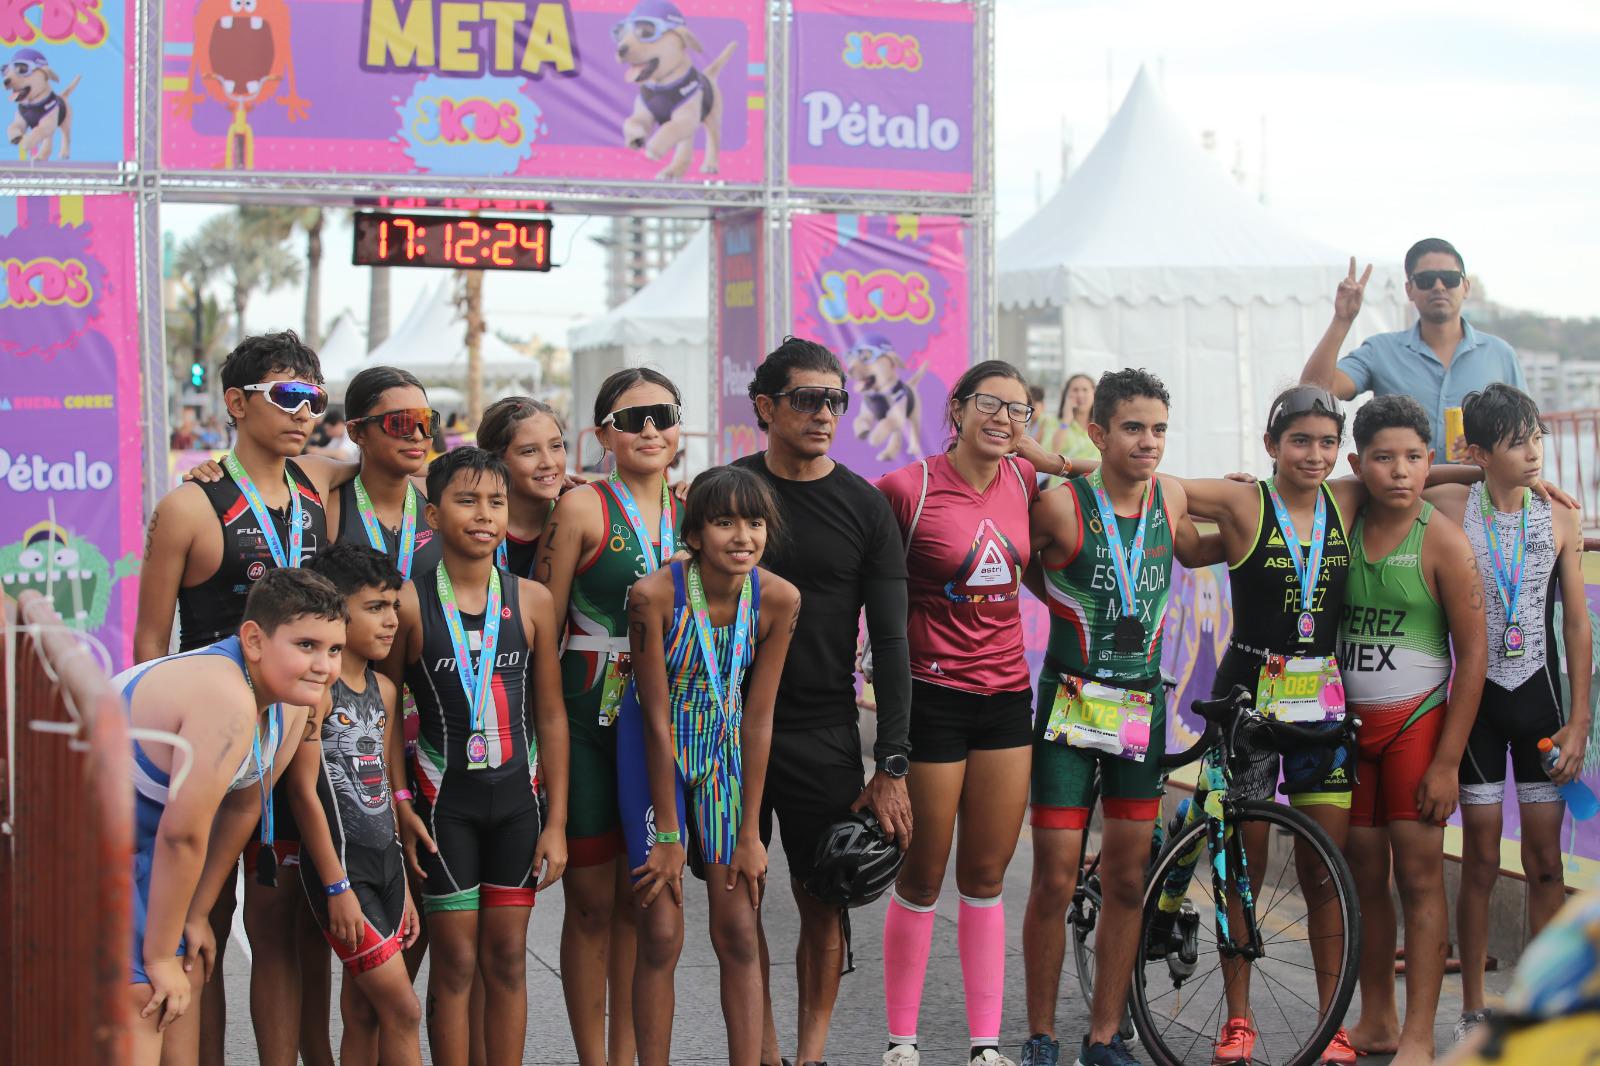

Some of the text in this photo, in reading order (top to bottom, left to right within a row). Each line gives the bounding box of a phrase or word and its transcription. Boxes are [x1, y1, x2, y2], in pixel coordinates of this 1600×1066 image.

[366, 0, 576, 74] META
[801, 90, 960, 151] Pétalo
[379, 218, 545, 266] 17:12:24
[1091, 563, 1165, 592] ESADA
[1284, 588, 1327, 613] PEEZ
[1343, 604, 1407, 637] PEREZ
[1341, 641, 1397, 672] MEX
[1284, 676, 1319, 696] 083
[1081, 701, 1119, 730] 072
